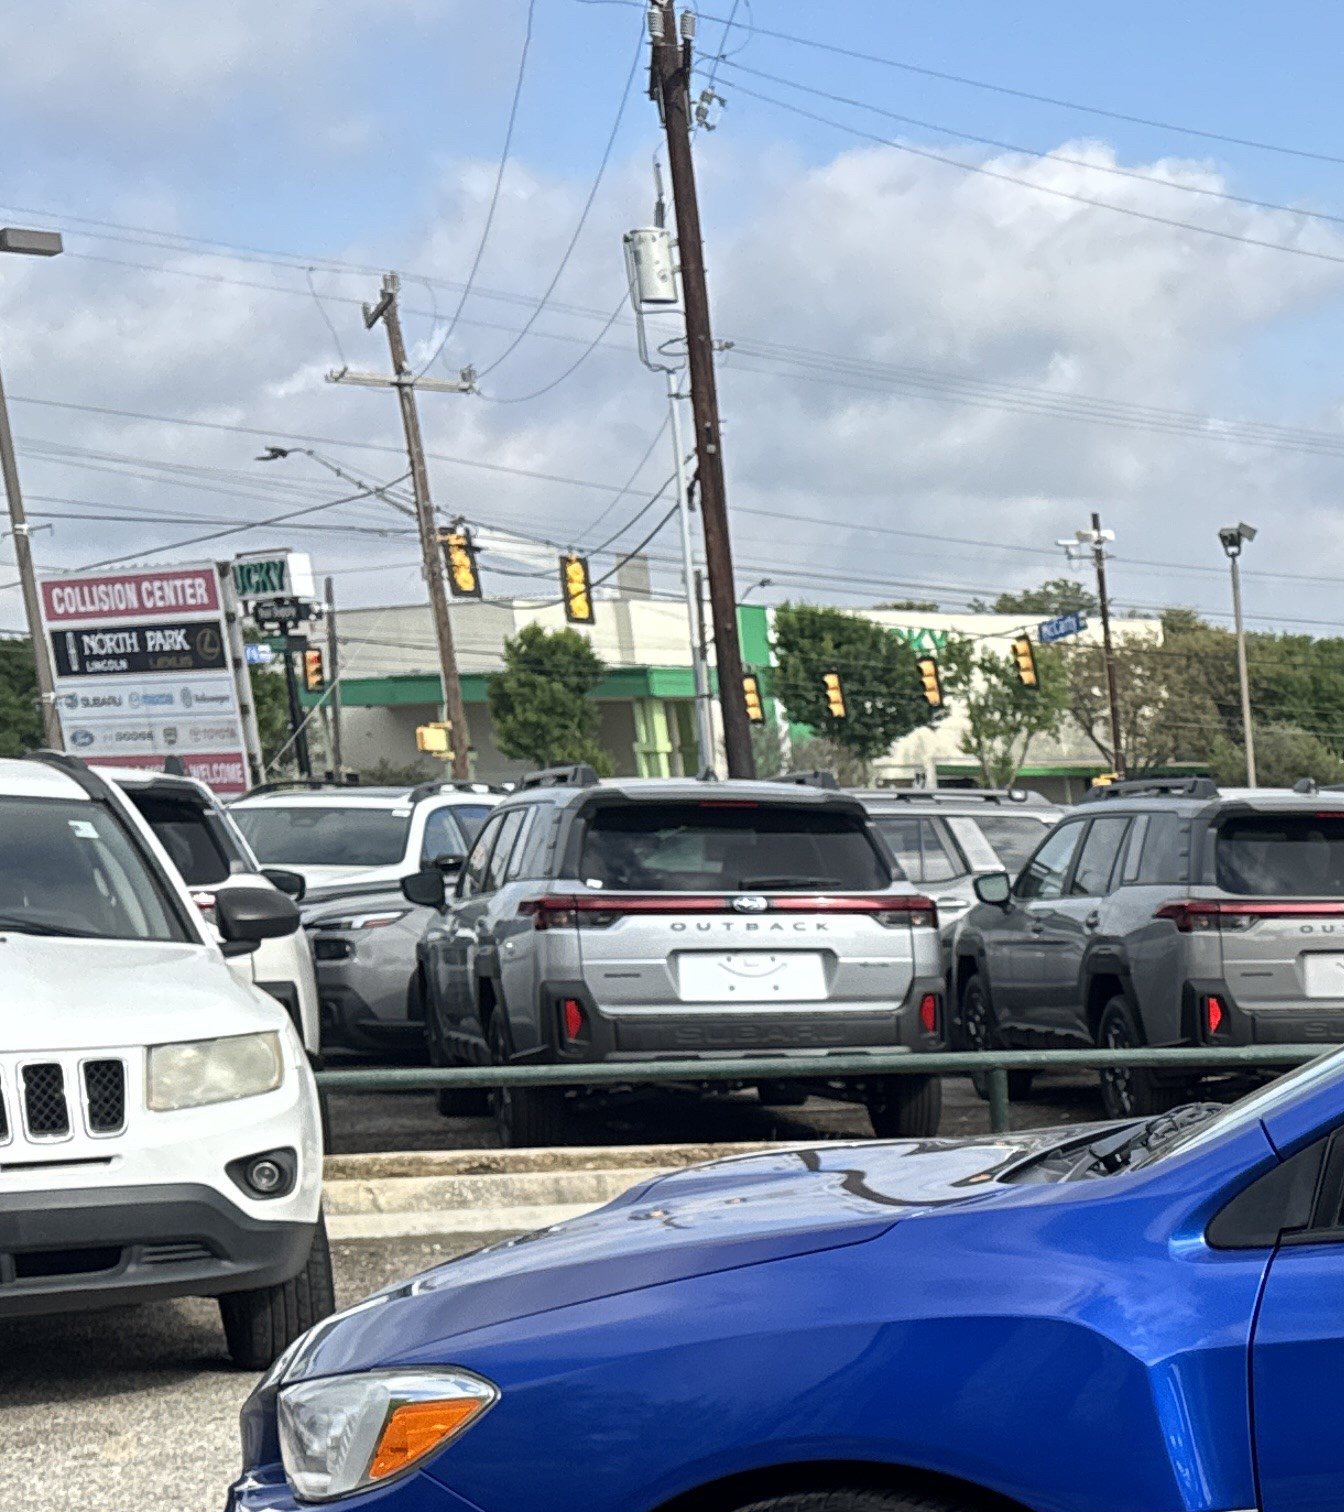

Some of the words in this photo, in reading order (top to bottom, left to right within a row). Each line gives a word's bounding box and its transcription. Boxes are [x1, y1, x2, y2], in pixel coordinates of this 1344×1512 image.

[52, 583, 139, 615] COLLISION
[141, 577, 209, 609] CENTER
[82, 632, 140, 656] NORTH
[146, 628, 191, 652] PARK
[669, 921, 831, 933] OUTBACK
